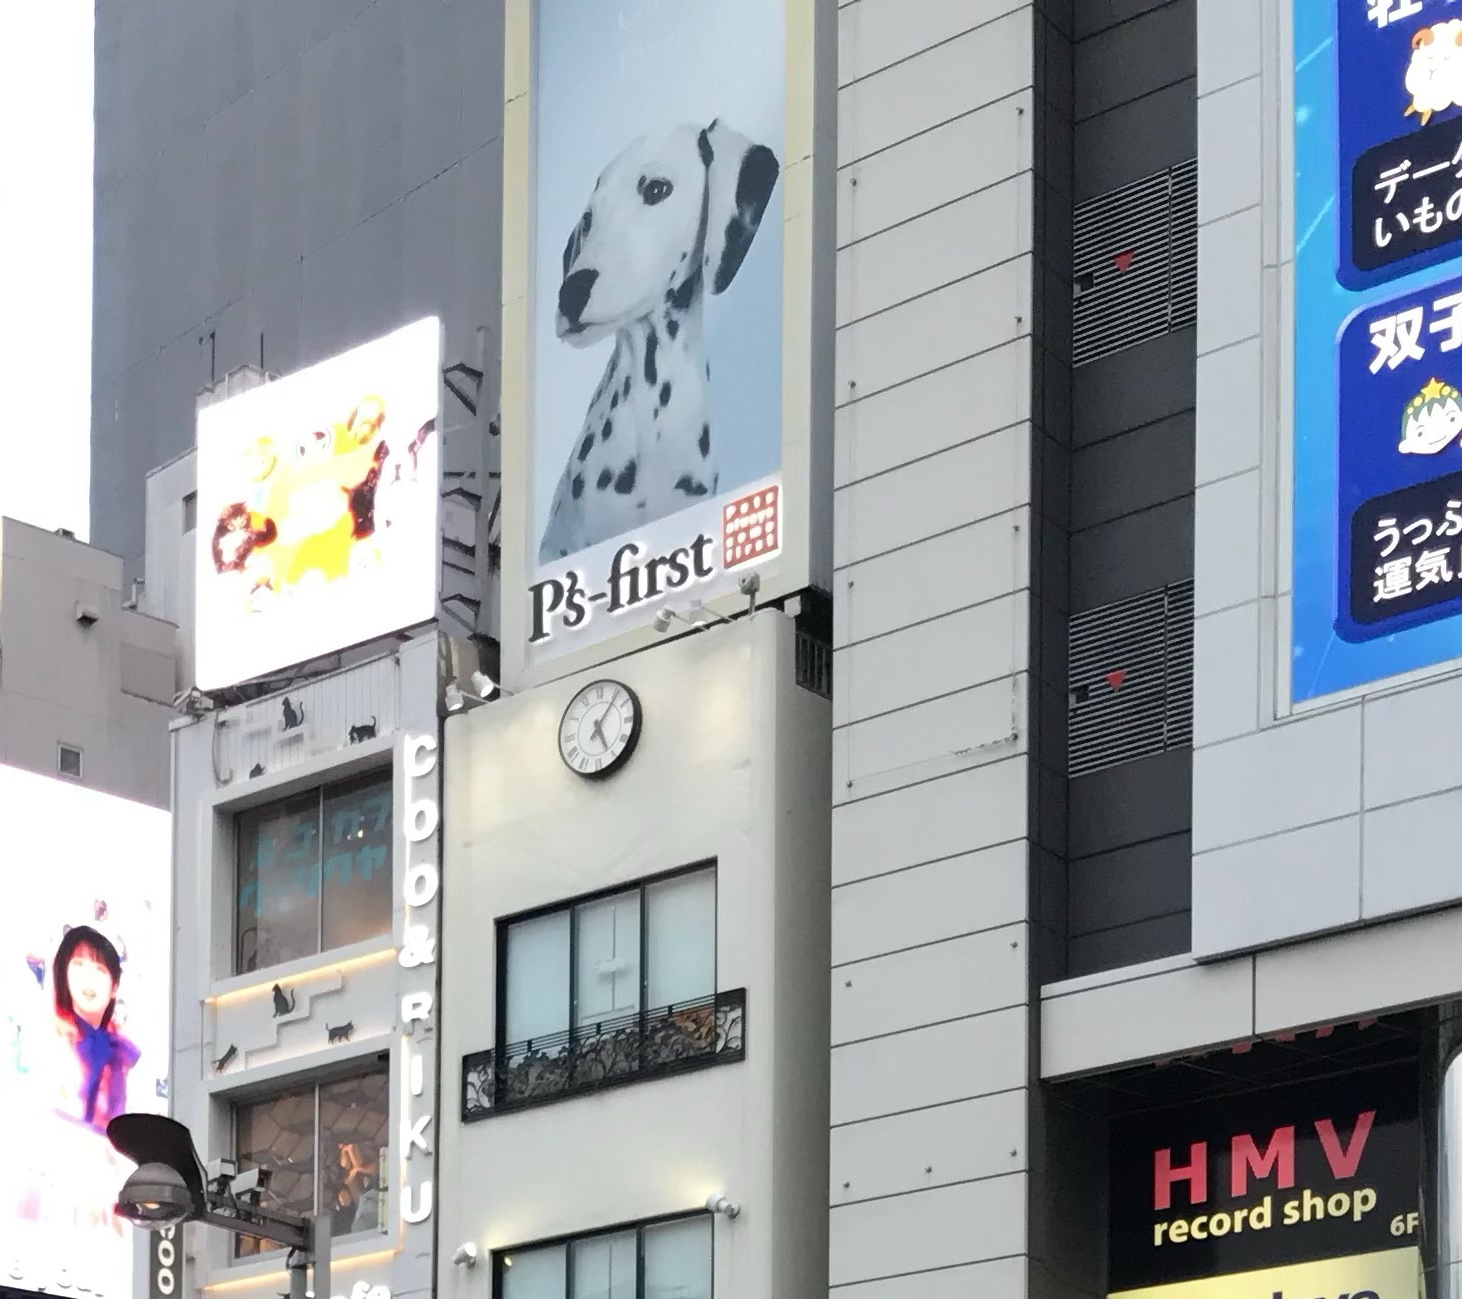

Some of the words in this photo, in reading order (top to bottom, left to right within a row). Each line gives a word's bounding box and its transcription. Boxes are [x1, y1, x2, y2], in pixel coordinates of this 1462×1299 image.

[1374, 141, 1462, 204] デー
[1372, 545, 1462, 602] 運気
[1154, 1109, 1377, 1210] HMV
[1153, 1198, 1272, 1247] record
[1282, 1186, 1378, 1227] shop
[1389, 1211, 1420, 1238] 6F
